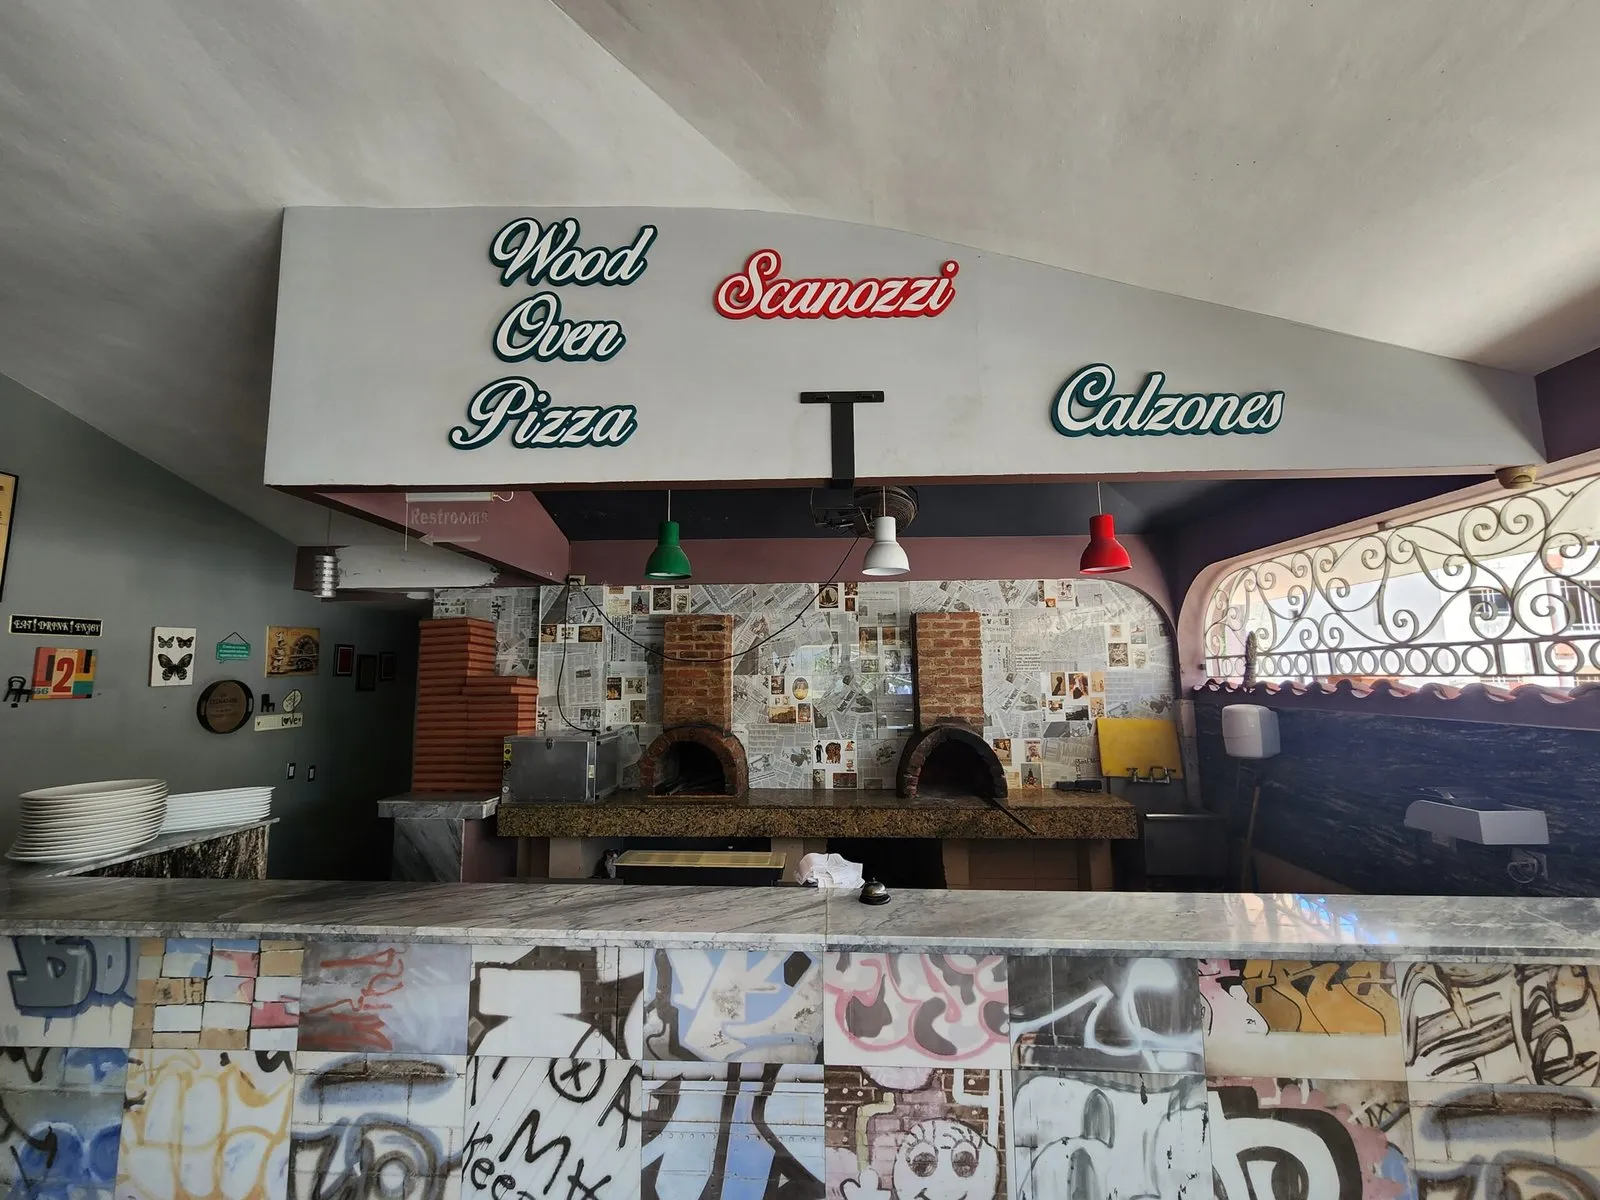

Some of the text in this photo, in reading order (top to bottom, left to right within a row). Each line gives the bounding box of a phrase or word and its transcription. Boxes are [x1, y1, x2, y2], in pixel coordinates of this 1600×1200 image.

[490, 217, 658, 287] Wood
[713, 249, 960, 319] Scanozzi
[493, 291, 626, 362] Oven
[449, 376, 638, 449] Pizza
[1051, 363, 1286, 437] Calzones
[410, 508, 489, 525] Restrooms
[13, 619, 33, 629] EAT
[37, 620, 69, 632] DRINK
